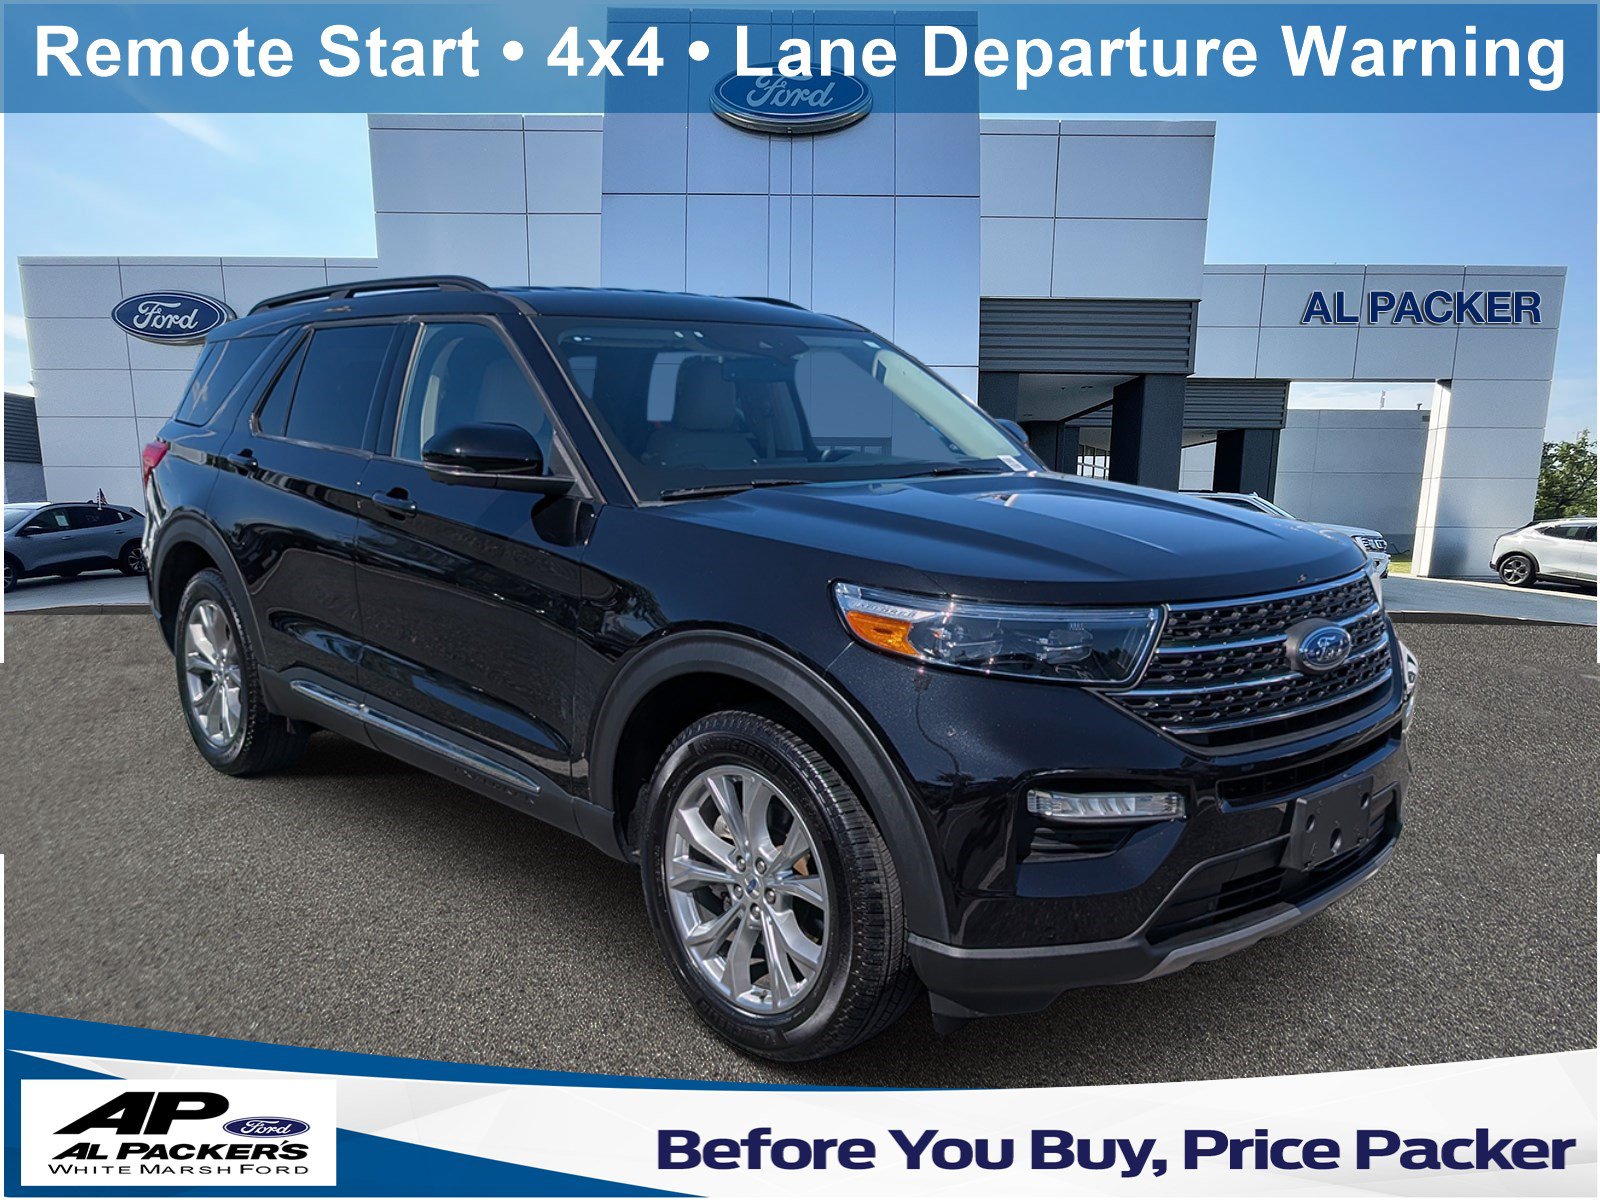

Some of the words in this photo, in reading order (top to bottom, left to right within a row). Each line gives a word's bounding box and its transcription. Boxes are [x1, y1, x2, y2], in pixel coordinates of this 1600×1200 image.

[746, 76, 836, 107] Ford
[133, 301, 199, 329] Ford
[1302, 290, 1360, 325] AL
[1369, 290, 1542, 325] PACKER
